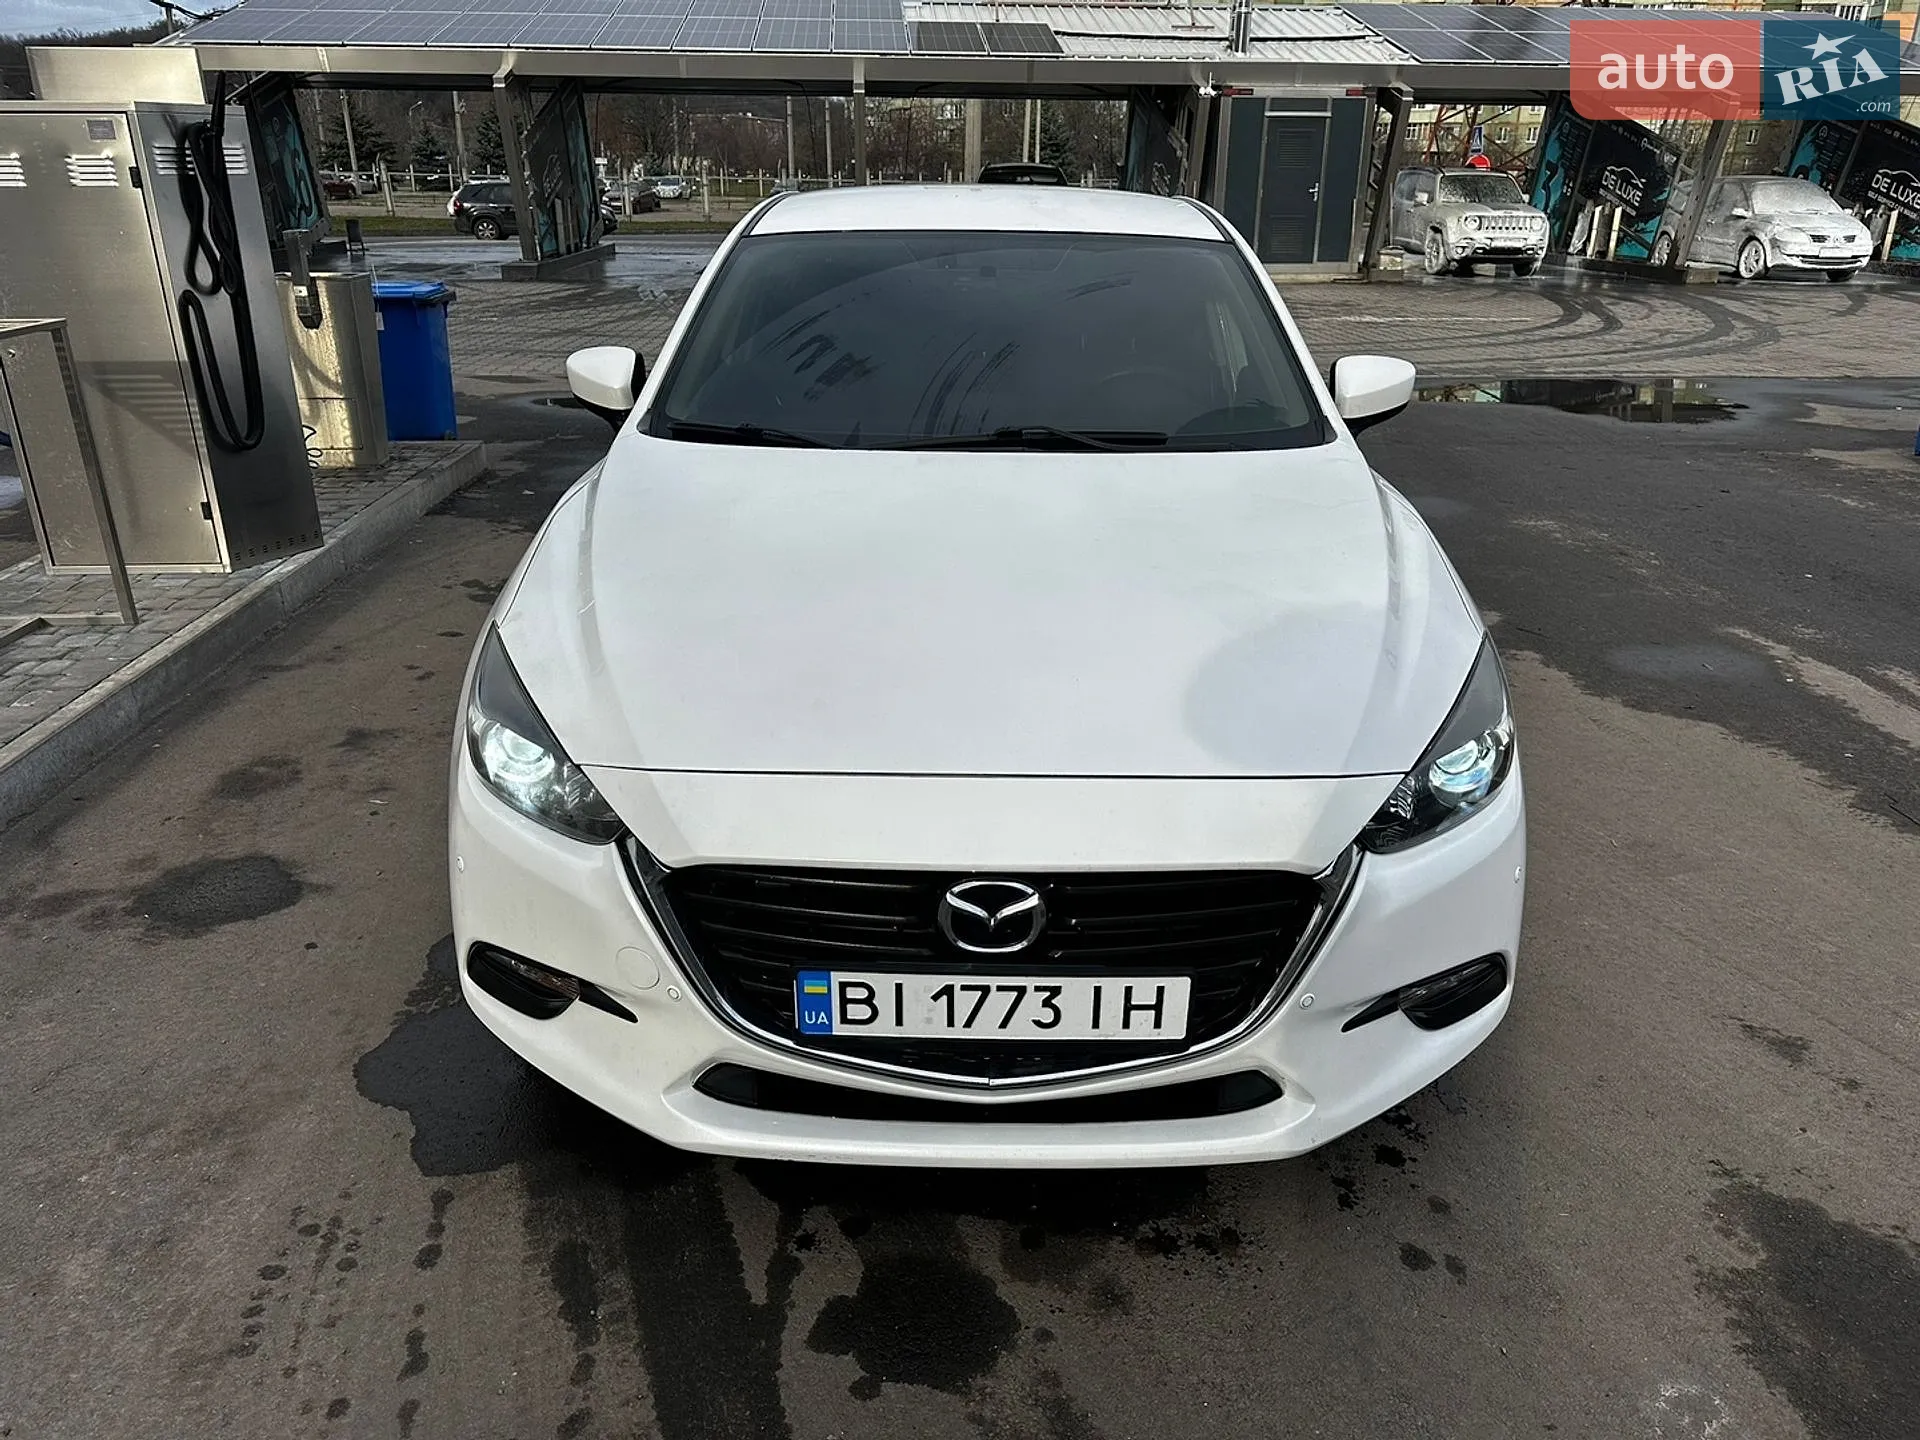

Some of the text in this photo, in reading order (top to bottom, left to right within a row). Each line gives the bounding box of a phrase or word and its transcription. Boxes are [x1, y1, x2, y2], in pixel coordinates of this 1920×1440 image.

[1615, 179, 1642, 206] LUXE
[1872, 174, 1891, 192] DE
[838, 981, 1165, 1029] BI 1773 IH
[805, 1011, 829, 1024] UA
